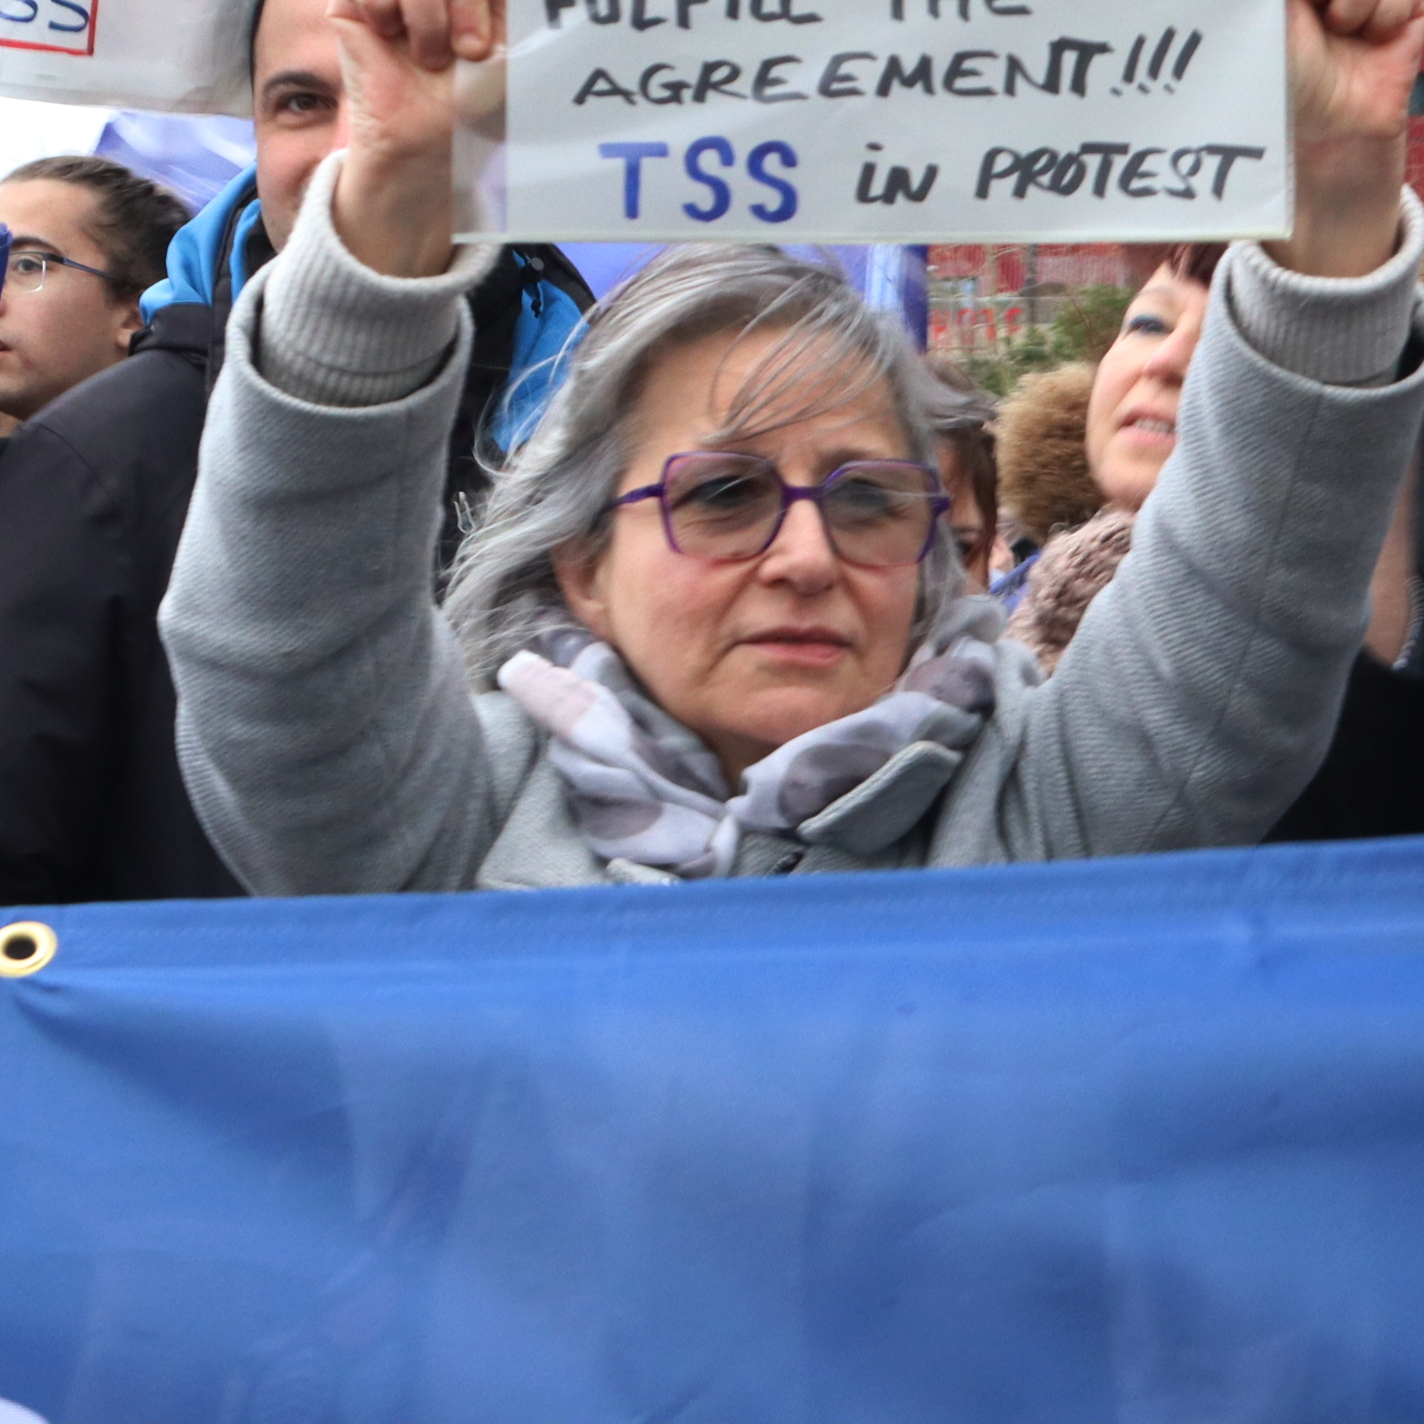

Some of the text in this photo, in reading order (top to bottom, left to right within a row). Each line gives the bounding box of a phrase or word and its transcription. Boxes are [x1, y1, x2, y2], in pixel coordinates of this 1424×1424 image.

[573, 28, 1203, 107] AGREEMENT!!!
[599, 136, 799, 223] TSS
[975, 144, 1266, 202] PROTEST
